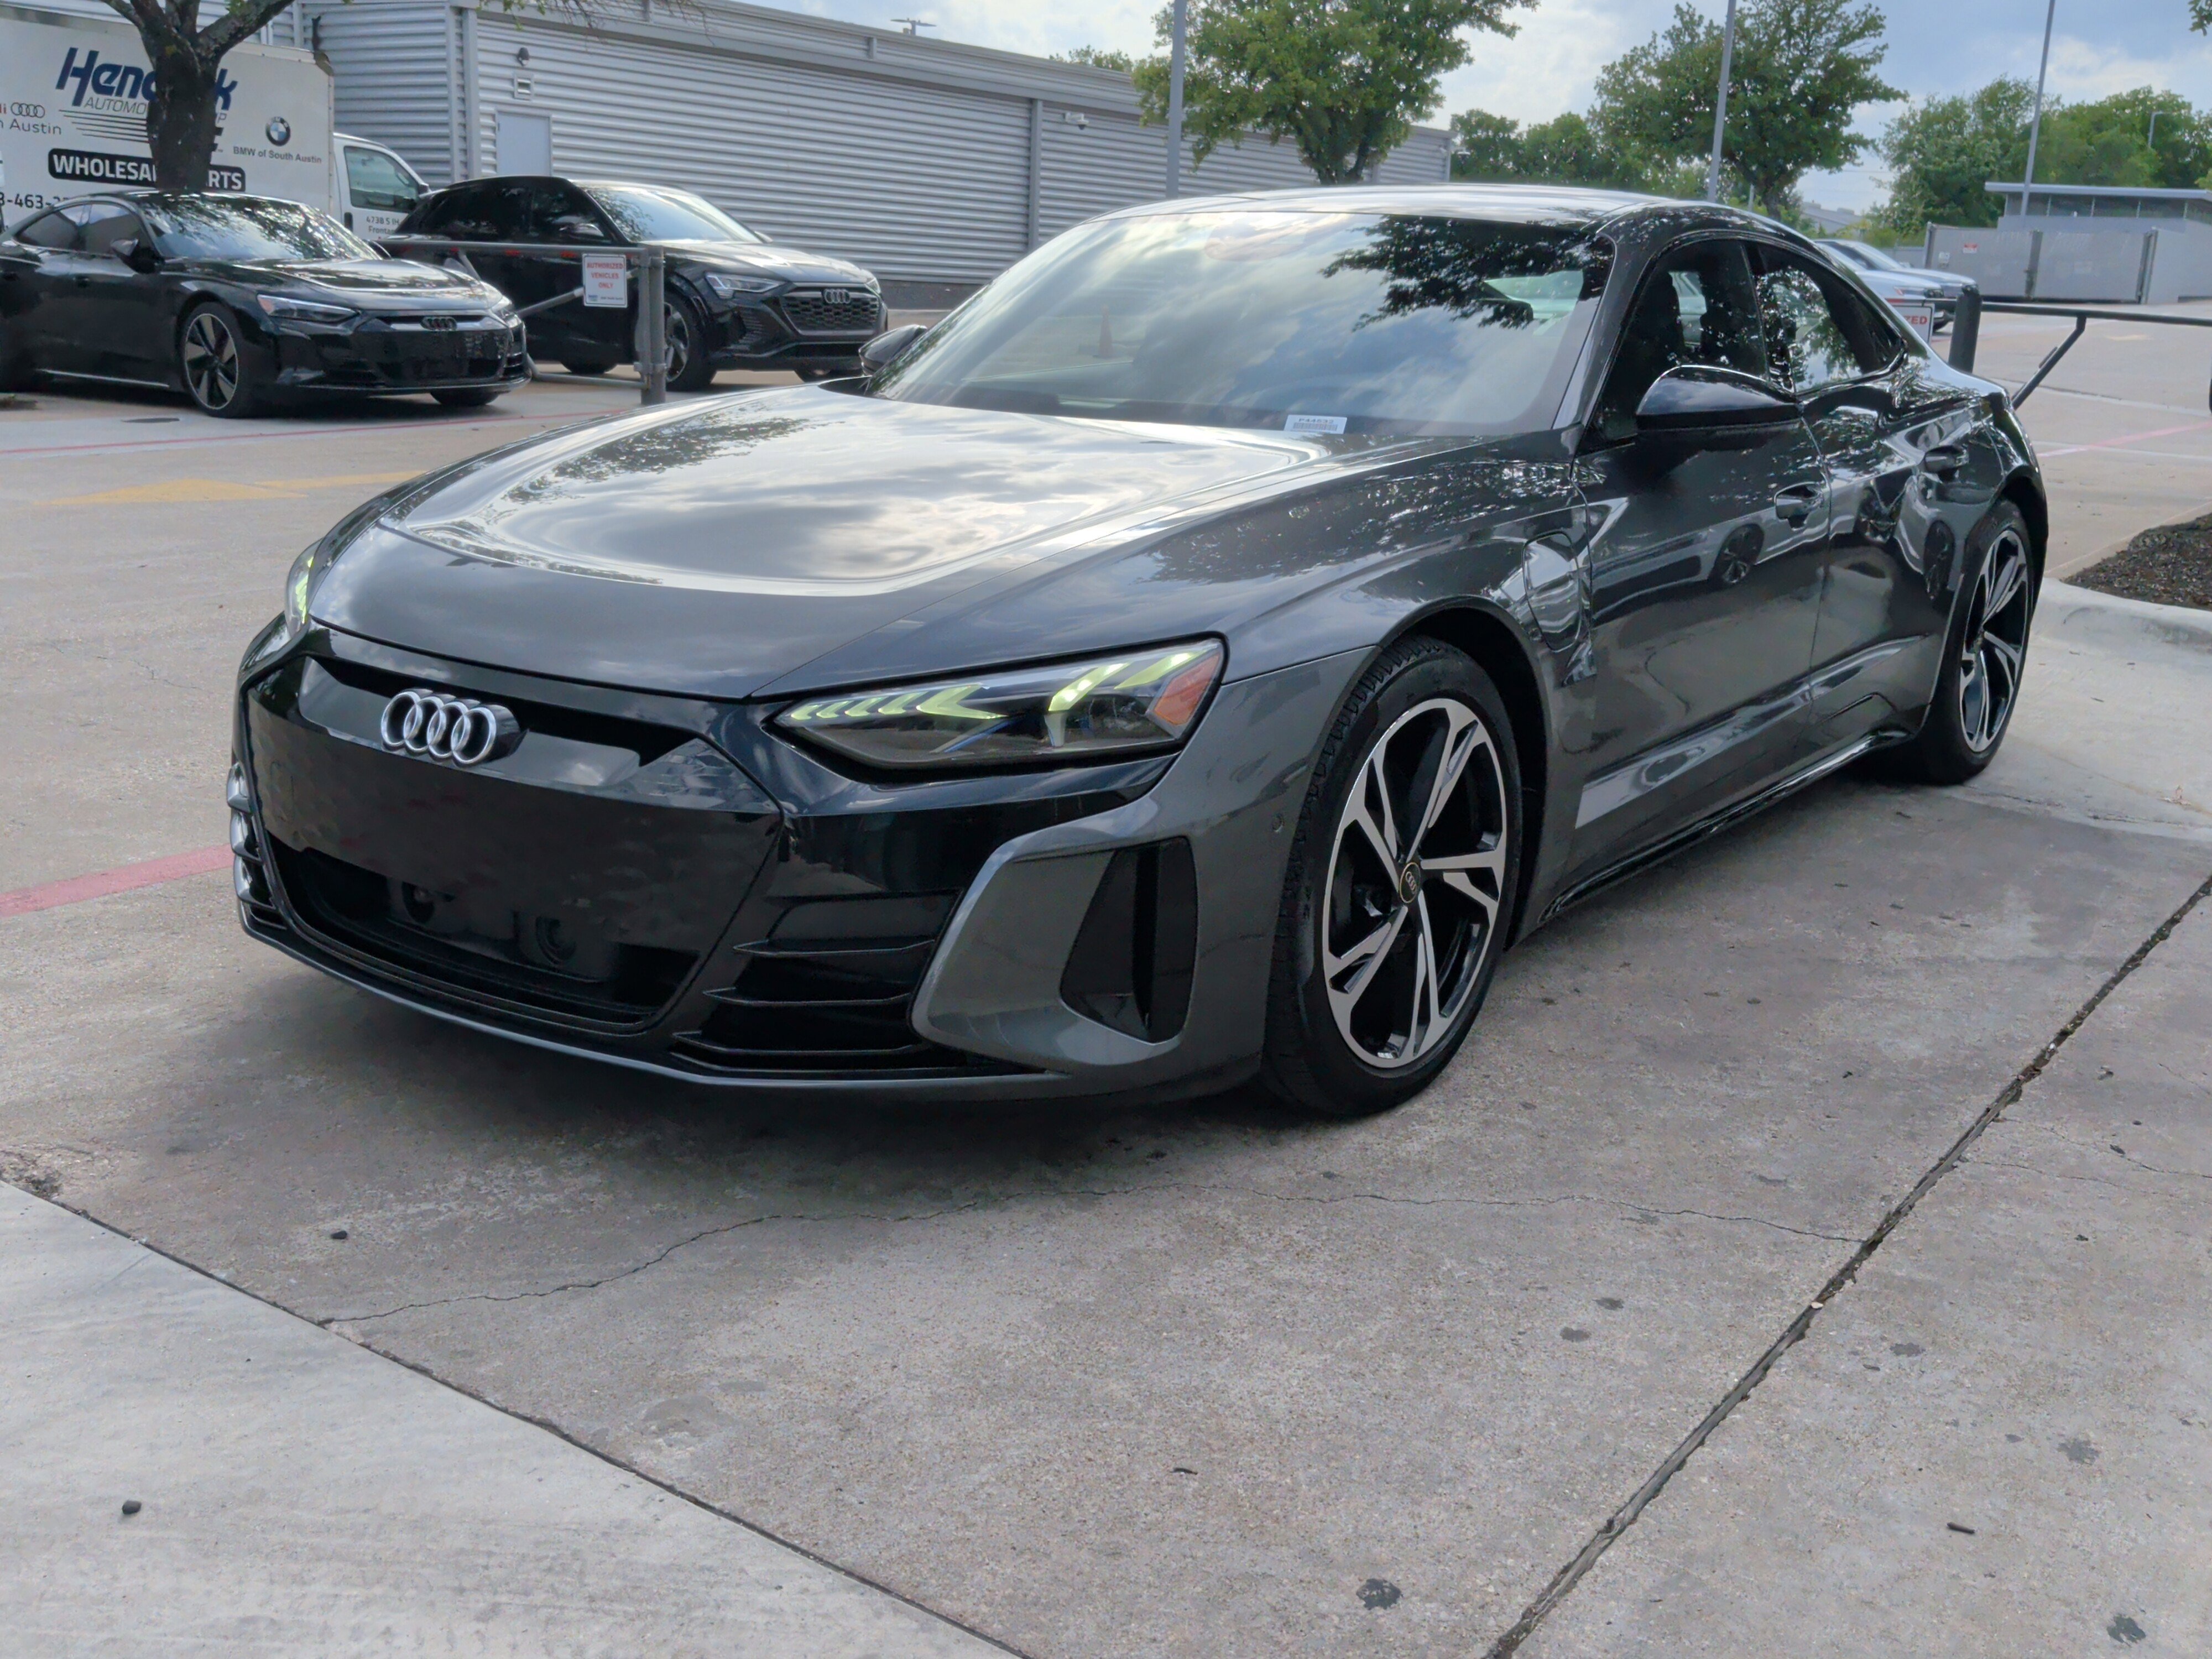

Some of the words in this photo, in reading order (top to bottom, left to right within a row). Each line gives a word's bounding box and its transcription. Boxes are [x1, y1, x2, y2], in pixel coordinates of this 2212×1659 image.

[9, 118, 61, 135] Austin
[233, 146, 256, 156] BMW
[258, 149, 266, 158] of
[269, 150, 293, 160] South
[295, 153, 322, 163] Austin
[53, 154, 157, 182] WHOLESA
